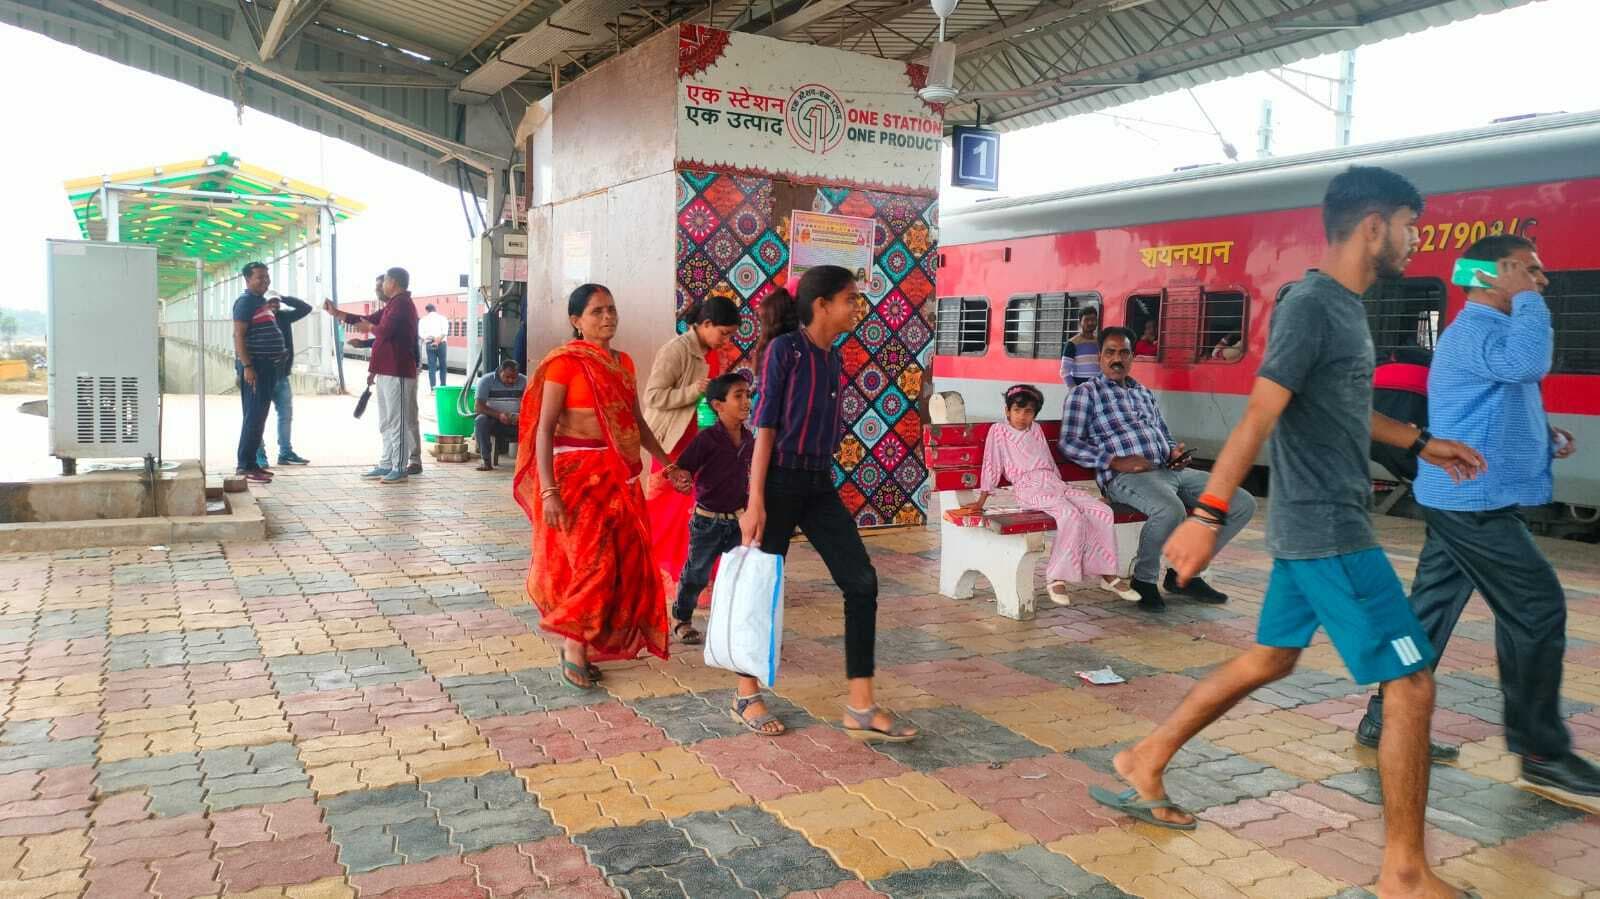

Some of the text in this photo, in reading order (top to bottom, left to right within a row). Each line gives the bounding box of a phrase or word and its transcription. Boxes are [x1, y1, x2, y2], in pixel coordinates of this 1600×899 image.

[686, 85, 785, 114] एक स्टेशन
[685, 106, 784, 136] एक उत्पाद
[848, 108, 942, 135] ONE STATION
[847, 127, 943, 152] ONE PRODUCT
[973, 141, 988, 176] 1
[1139, 240, 1235, 269] शयनयान
